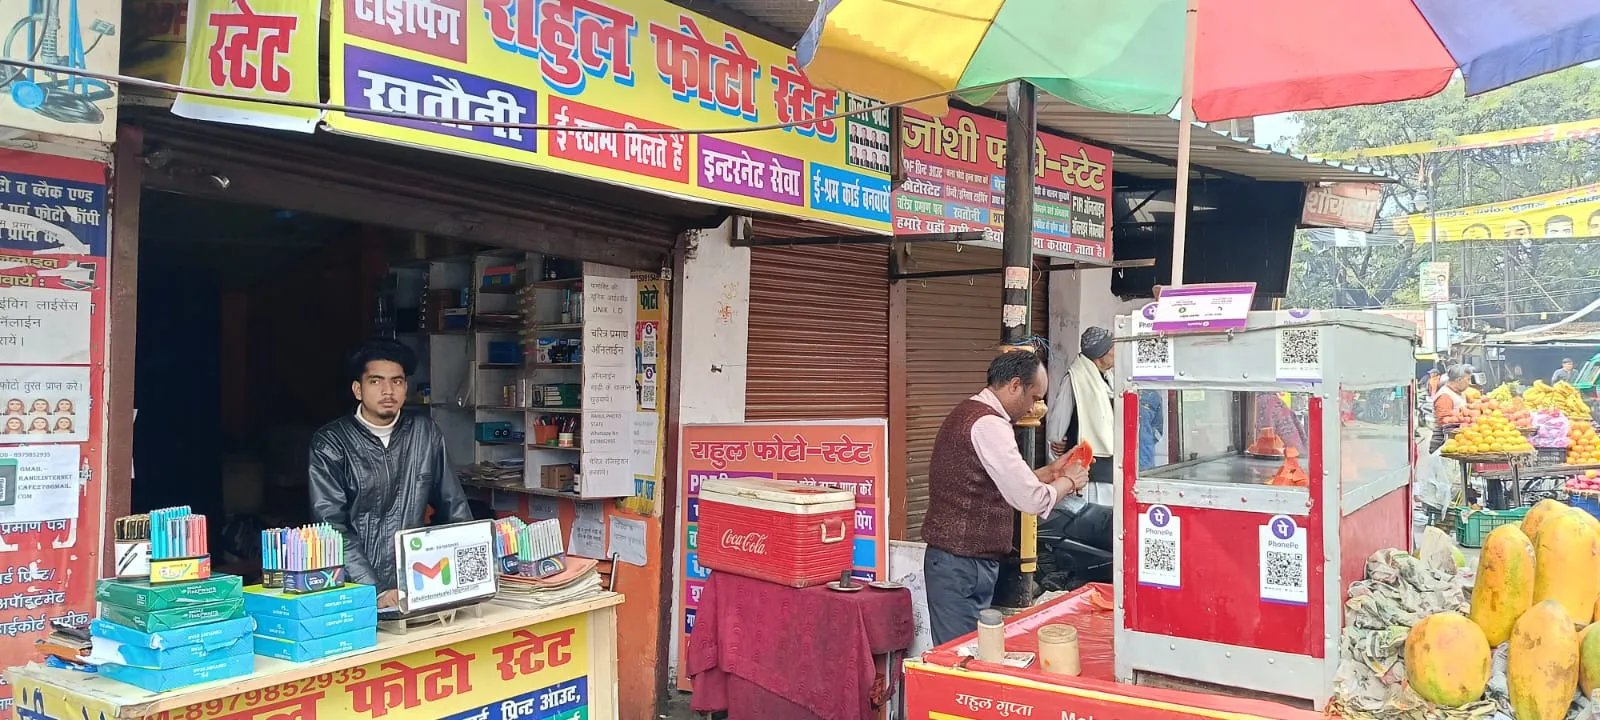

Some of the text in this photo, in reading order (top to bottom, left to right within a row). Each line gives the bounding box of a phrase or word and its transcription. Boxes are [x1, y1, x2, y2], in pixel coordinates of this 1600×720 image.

[208, 0, 298, 93] स्टेट
[483, 0, 634, 88] राहुल
[650, 15, 760, 121] फोटो
[358, 70, 526, 141] खतौनी
[624, 122, 668, 169] मिलते
[902, 115, 980, 163] जोशी
[702, 149, 801, 197] इन्टरनेट सेवा
[16, 181, 26, 195] व
[31, 181, 63, 199] ब्लैक
[67, 188, 94, 203] एण्ड
[813, 174, 839, 205] ई-श्रम
[841, 180, 860, 209] कार्ड
[1072, 196, 1083, 213] FIR
[34, 203, 66, 222] फोटो
[895, 216, 921, 231] हमारे
[1047, 240, 1072, 252] कराया
[1074, 244, 1094, 256] जाता
[639, 284, 659, 310] फोटो
[46, 382, 62, 391] प्राप्त
[691, 441, 750, 470] राहुल
[859, 479, 873, 496] करें
[1, 518, 67, 535] प्रमाण पत्र
[1145, 527, 1173, 537] PhonePe
[1267, 540, 1299, 550] PhonePe
[345, 647, 476, 718] फोटो
[493, 628, 576, 681] स्टेट
[955, 693, 1034, 717] राहुल गुप्ता
